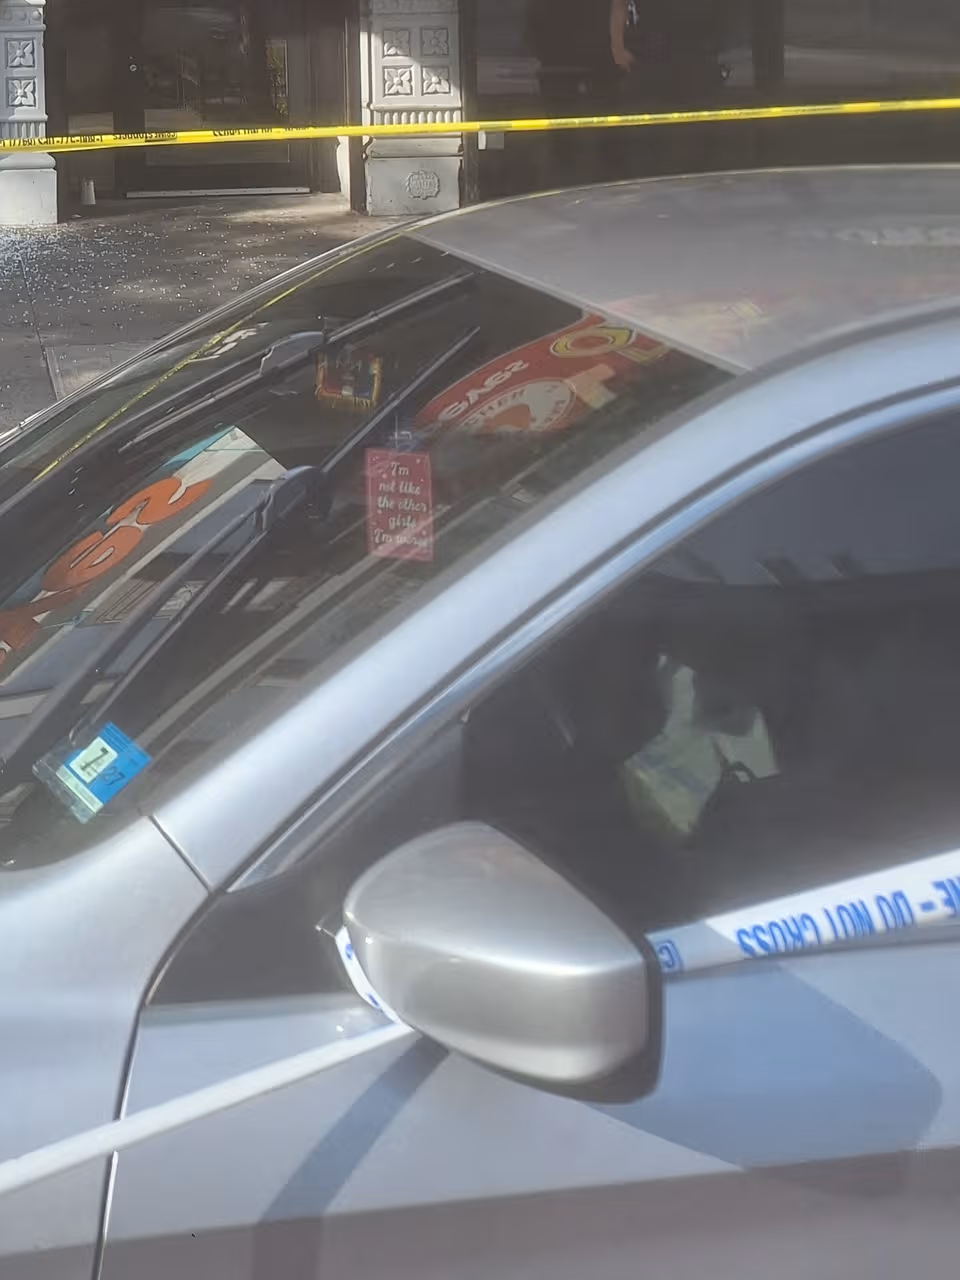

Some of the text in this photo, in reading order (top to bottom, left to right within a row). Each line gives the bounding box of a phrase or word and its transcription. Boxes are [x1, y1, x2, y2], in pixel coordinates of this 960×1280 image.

[398, 498, 427, 512] other
[737, 913, 821, 958] CROSS
[823, 900, 874, 939] NOT
